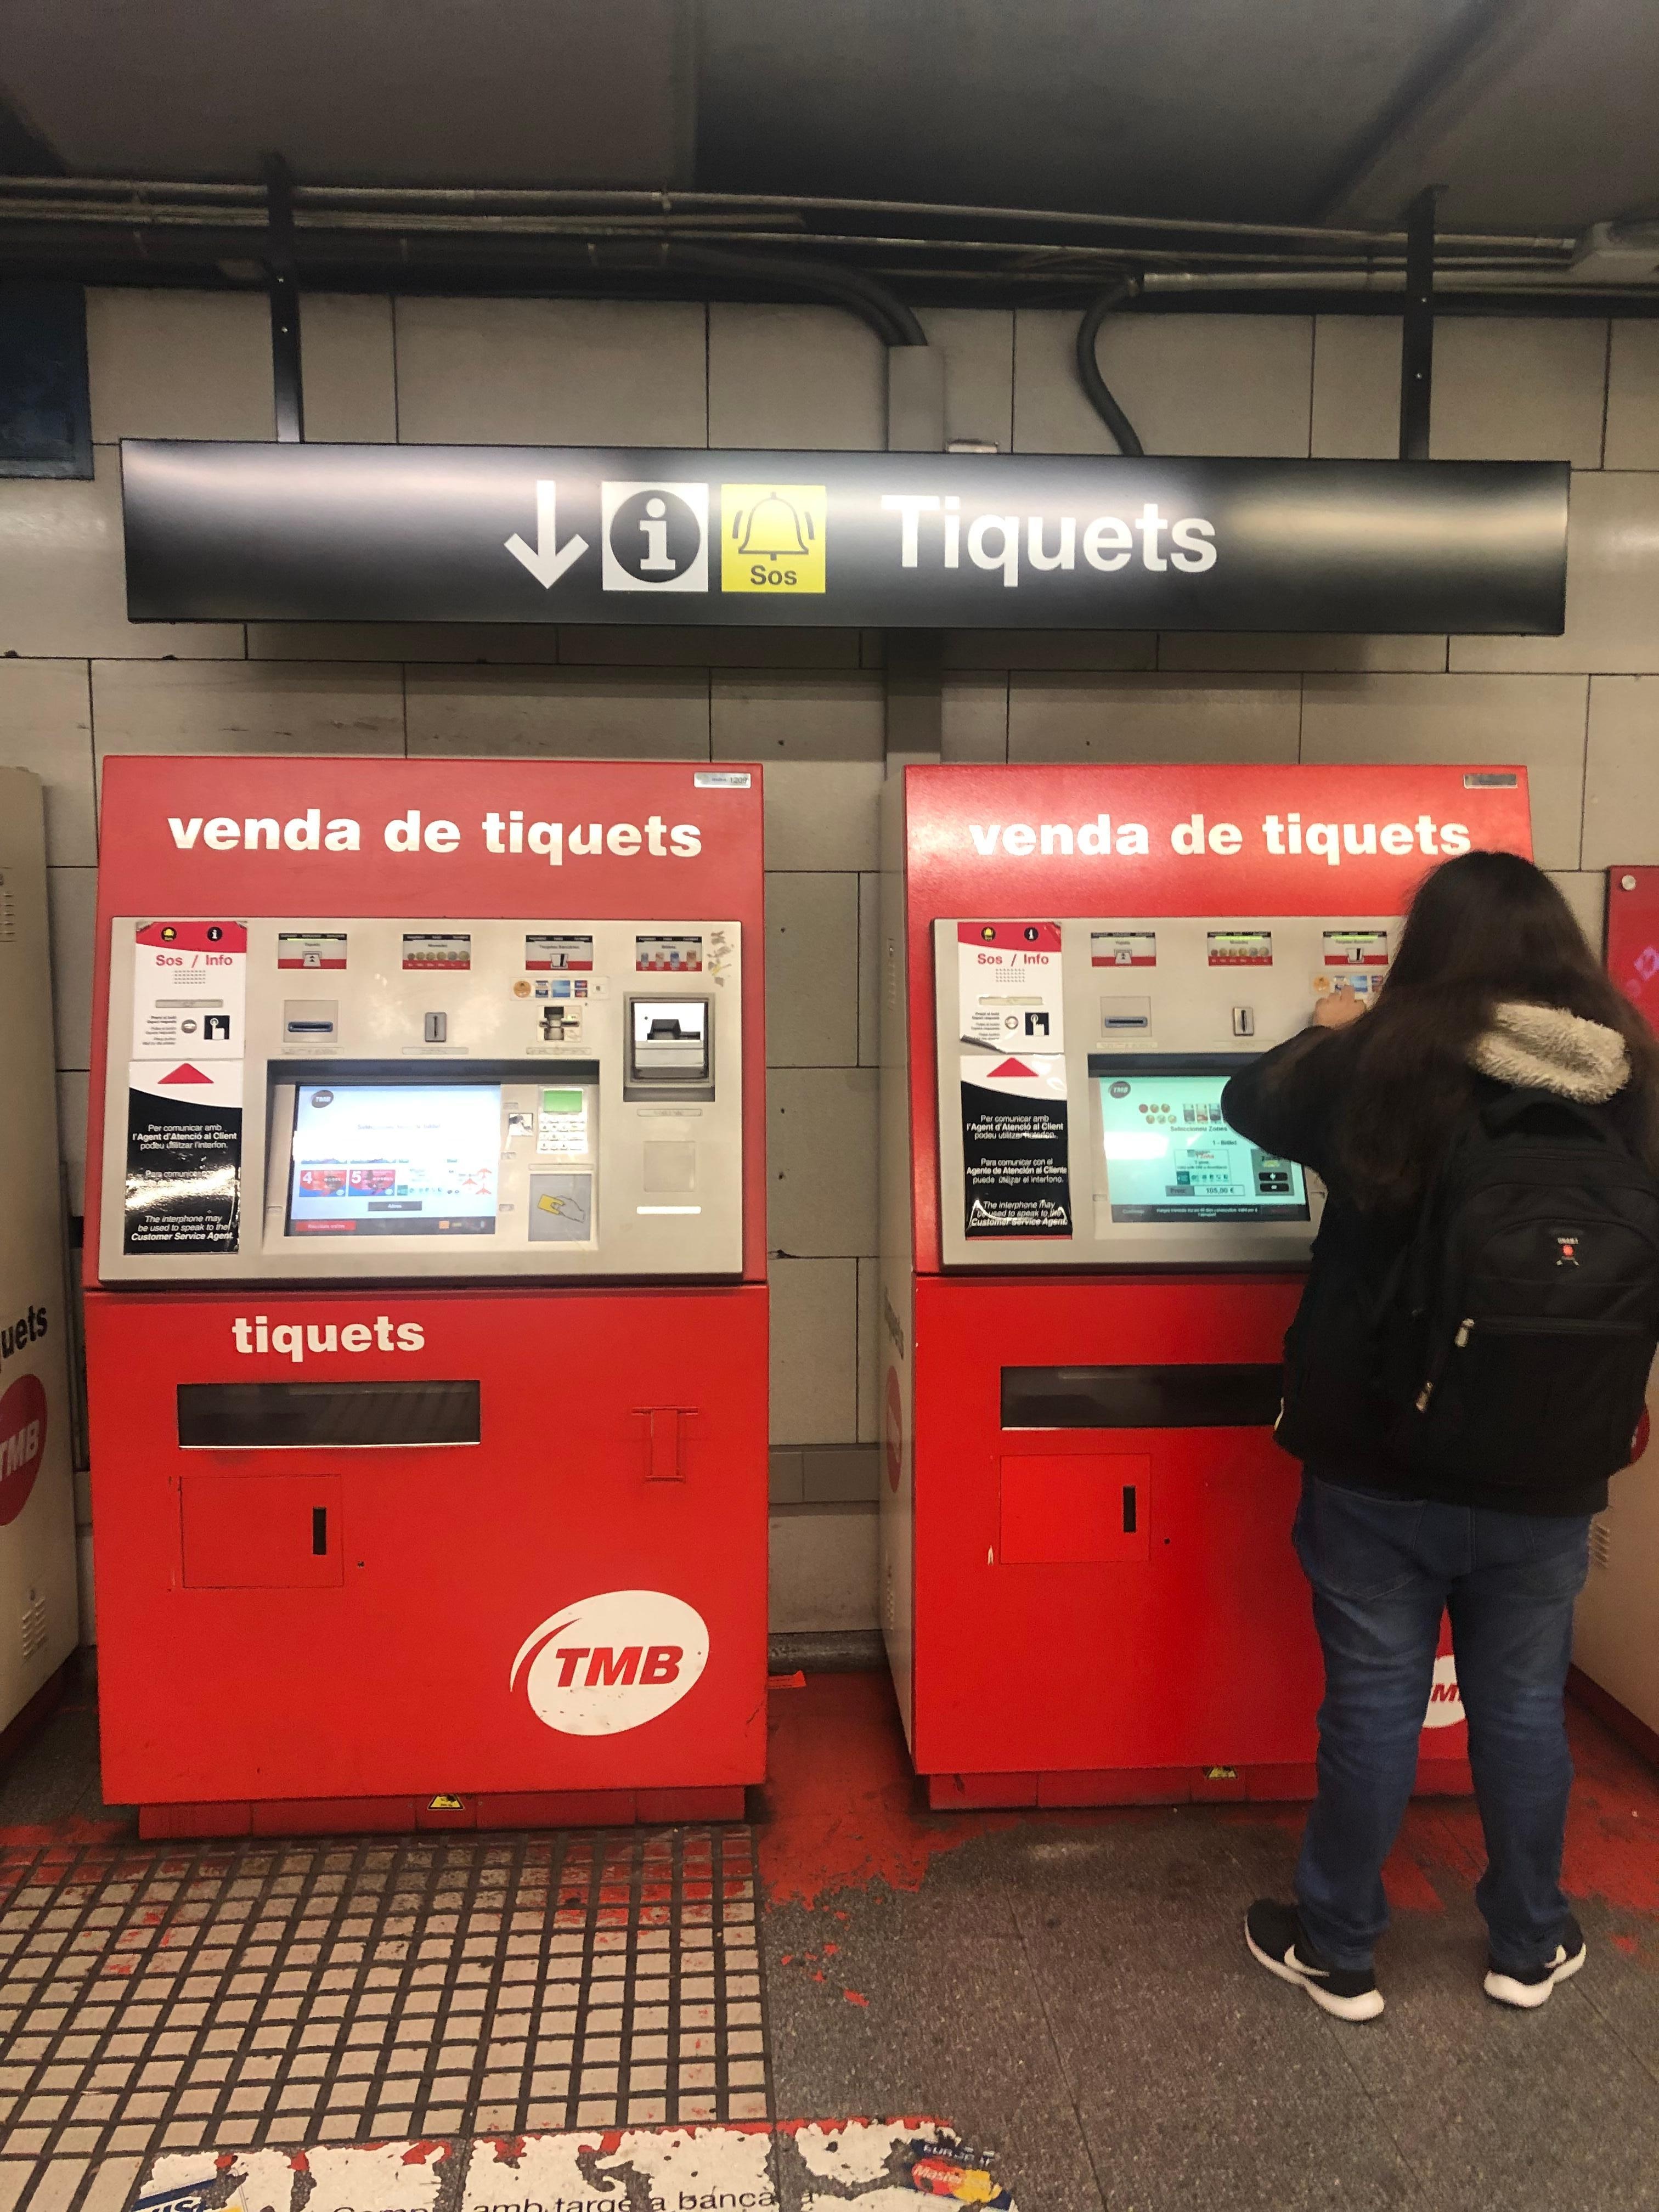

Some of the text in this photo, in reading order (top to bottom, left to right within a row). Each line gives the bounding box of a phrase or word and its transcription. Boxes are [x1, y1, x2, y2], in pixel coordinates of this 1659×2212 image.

[882, 495, 1217, 586] Tiquets
[750, 565, 797, 585] Sos
[168, 809, 703, 866] venda de tiquets
[969, 812, 1471, 865] venda de tiquets
[155, 954, 183, 966] Sos
[205, 955, 233, 966] Info
[977, 953, 1003, 964] Sos
[1024, 953, 1049, 964] Info
[980, 1114, 993, 1122] Per
[1033, 1122, 1040, 1131] al
[1041, 1122, 1063, 1131] Client
[132, 1133, 161, 1142] l'Agent
[163, 1132, 202, 1141] d'Atenció
[213, 1132, 238, 1140] Client
[974, 1132, 997, 1140] podeu
[140, 1142, 165, 1151] podeu
[981, 1158, 996, 1166] Para
[145, 1170, 162, 1178] Para
[967, 1167, 991, 1176] Agente
[992, 1166, 1002, 1175] de
[1003, 1166, 1034, 1175] Atención
[1043, 1166, 1067, 1174] Cliente
[351, 1171, 362, 1184] 5
[973, 1176, 995, 1185] puede
[983, 1200, 1056, 1210] The interphone may
[989, 1210, 1007, 1218] used
[1017, 1209, 1039, 1218] speak
[1041, 1209, 1048, 1217] to
[161, 1215, 203, 1224] interphone
[205, 1216, 222, 1224] may
[971, 1218, 1009, 1227] Customer
[1011, 1217, 1040, 1226] Service
[180, 1224, 204, 1233] speak
[131, 1233, 173, 1241] Customer
[174, 1232, 206, 1240] Service
[1, 1305, 48, 1359] uets
[232, 1315, 425, 1363] tiquets
[555, 1645, 684, 1688] TMB
